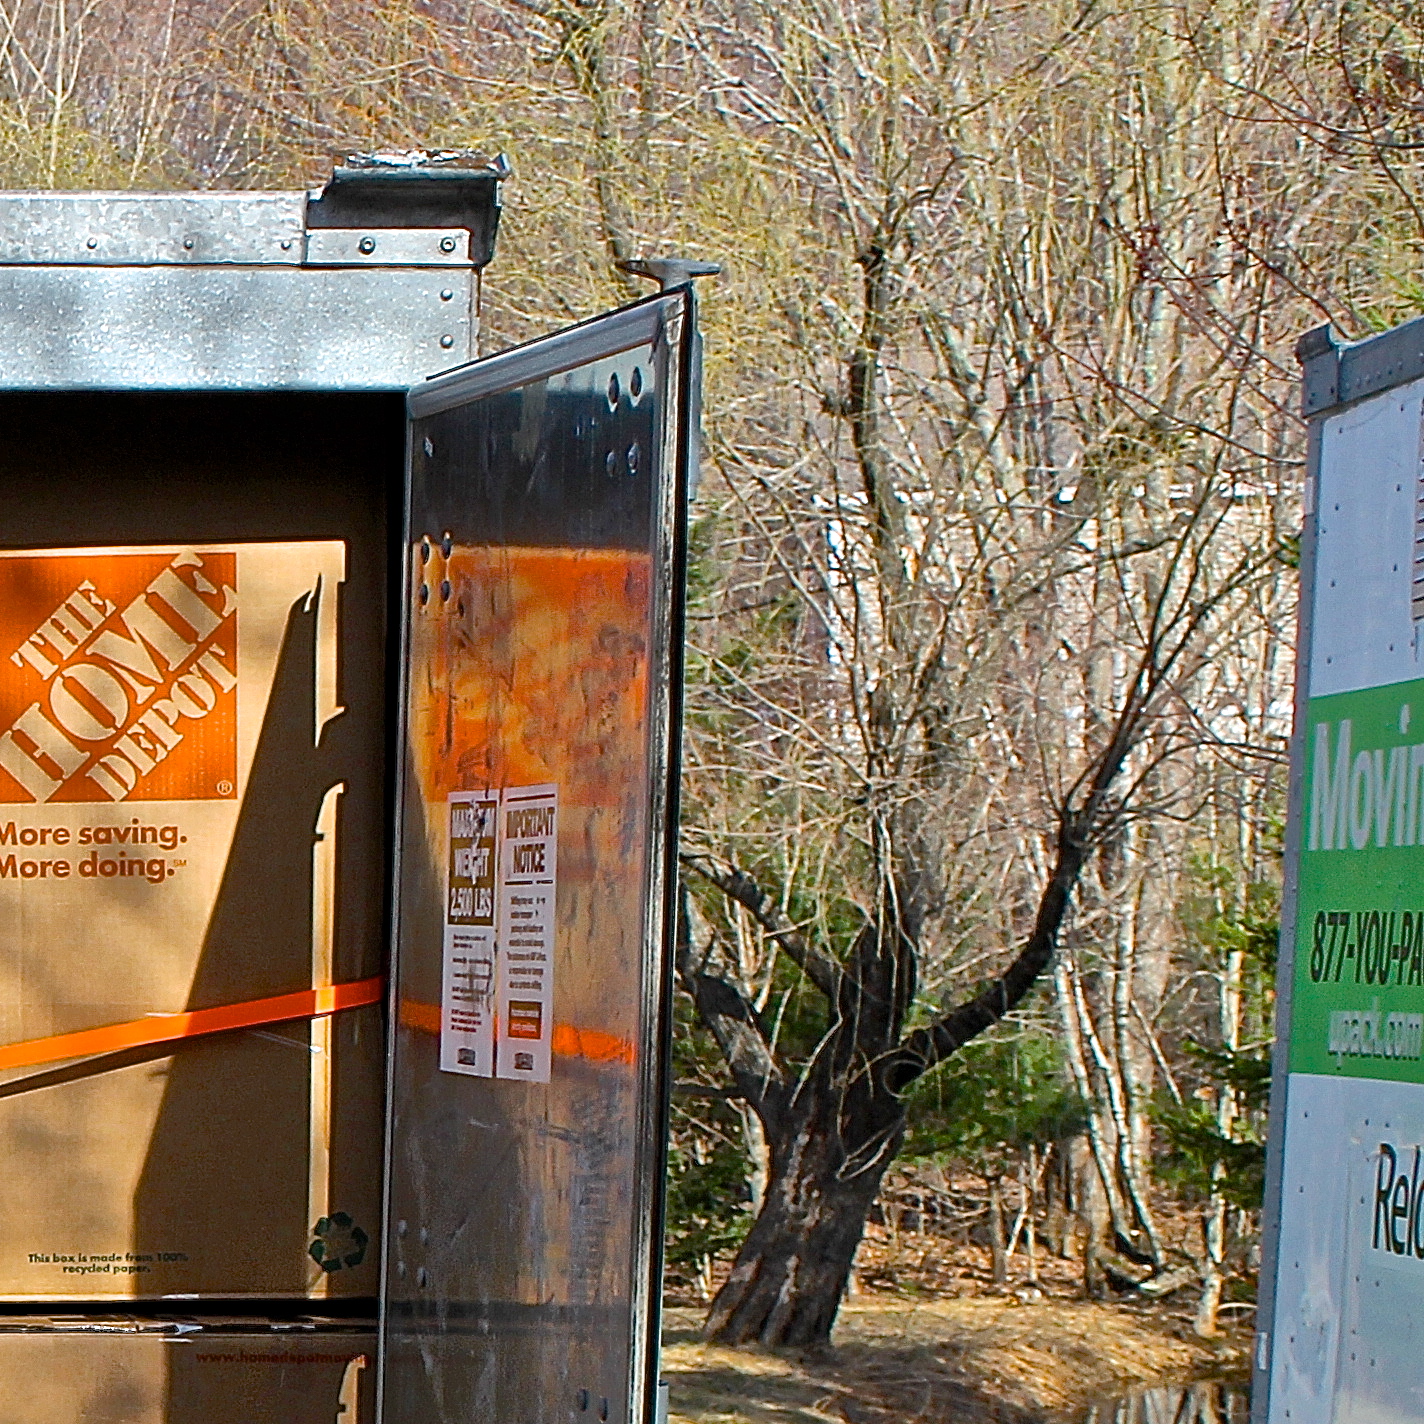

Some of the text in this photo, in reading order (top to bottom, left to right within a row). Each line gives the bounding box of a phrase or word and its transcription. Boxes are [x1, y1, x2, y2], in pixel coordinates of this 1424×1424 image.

[11, 579, 116, 681] THE
[85, 643, 237, 802] DEPOT
[78, 819, 187, 851] saving.
[78, 851, 175, 884] doing.
[513, 843, 546, 875] NOTICE
